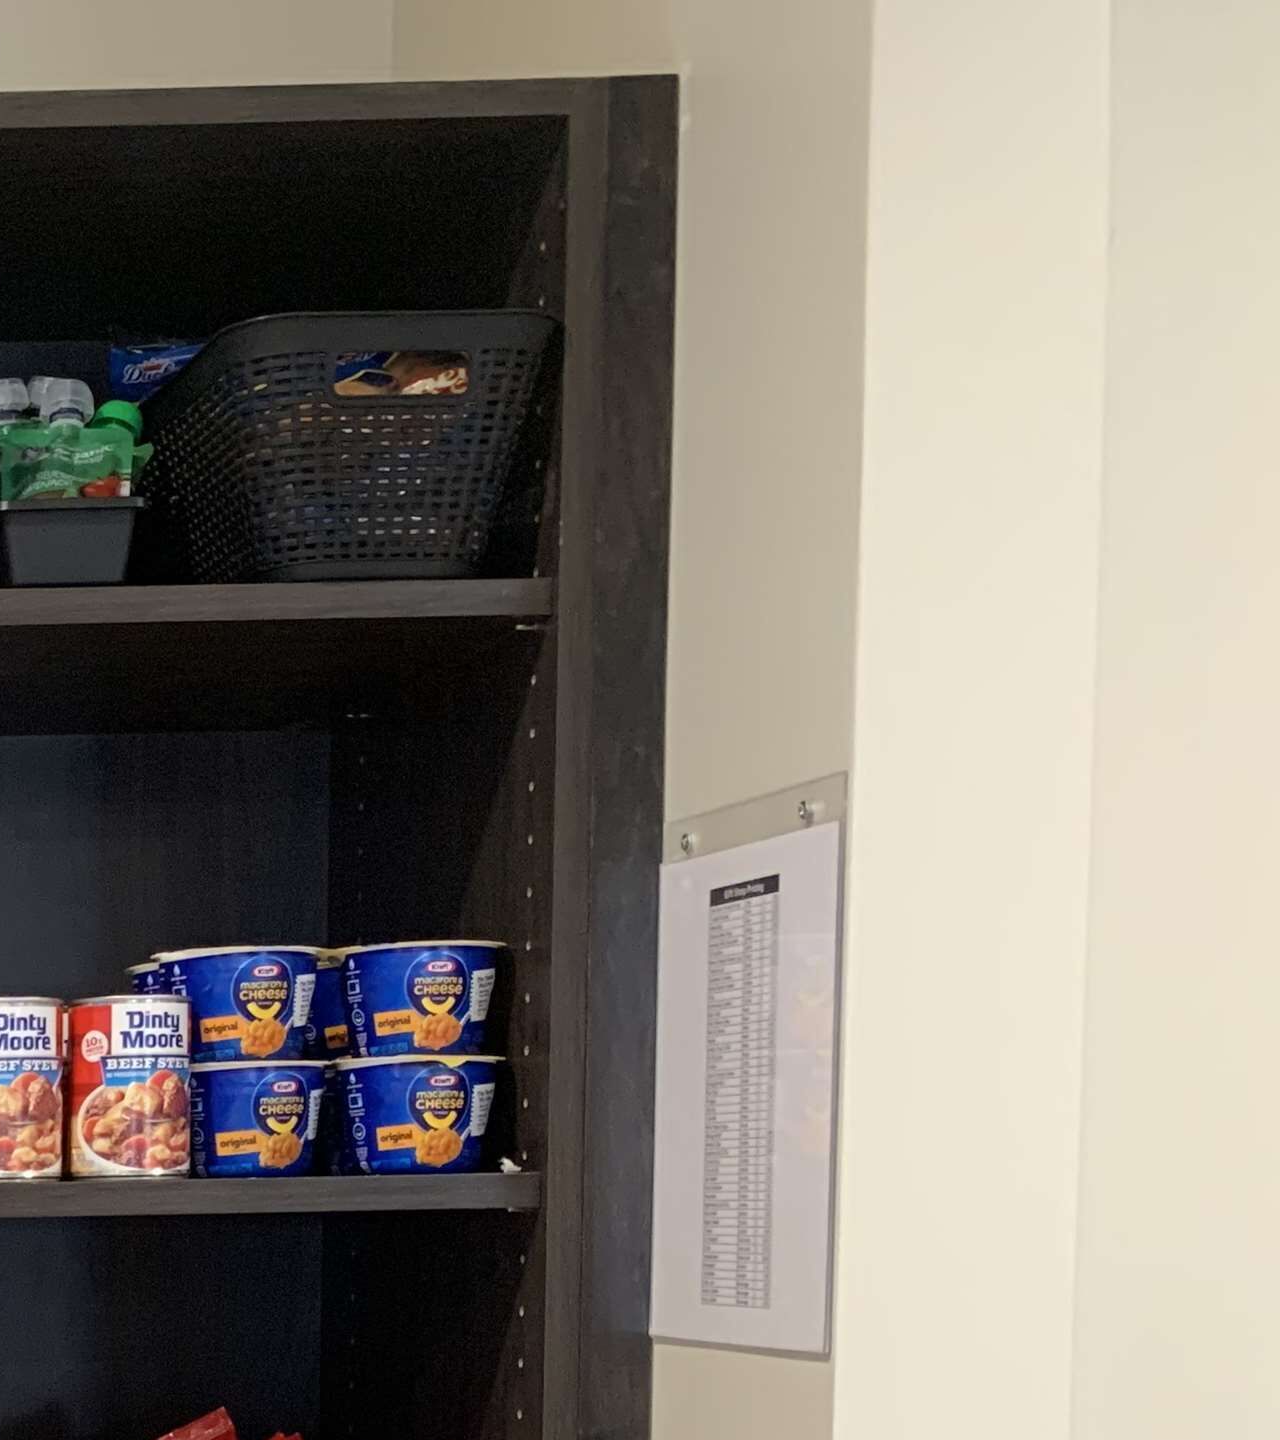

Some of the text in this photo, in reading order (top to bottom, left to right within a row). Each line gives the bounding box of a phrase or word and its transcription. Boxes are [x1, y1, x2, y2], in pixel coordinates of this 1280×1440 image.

[240, 980, 282, 991] macaroni
[413, 975, 457, 987] macaroni
[125, 1011, 181, 1033] Dinty
[203, 1022, 239, 1036] original
[377, 1015, 412, 1031] original
[119, 1030, 185, 1049] Moore
[106, 1057, 156, 1070] BEEF
[219, 1135, 257, 1150] original
[379, 1130, 413, 1144] original
